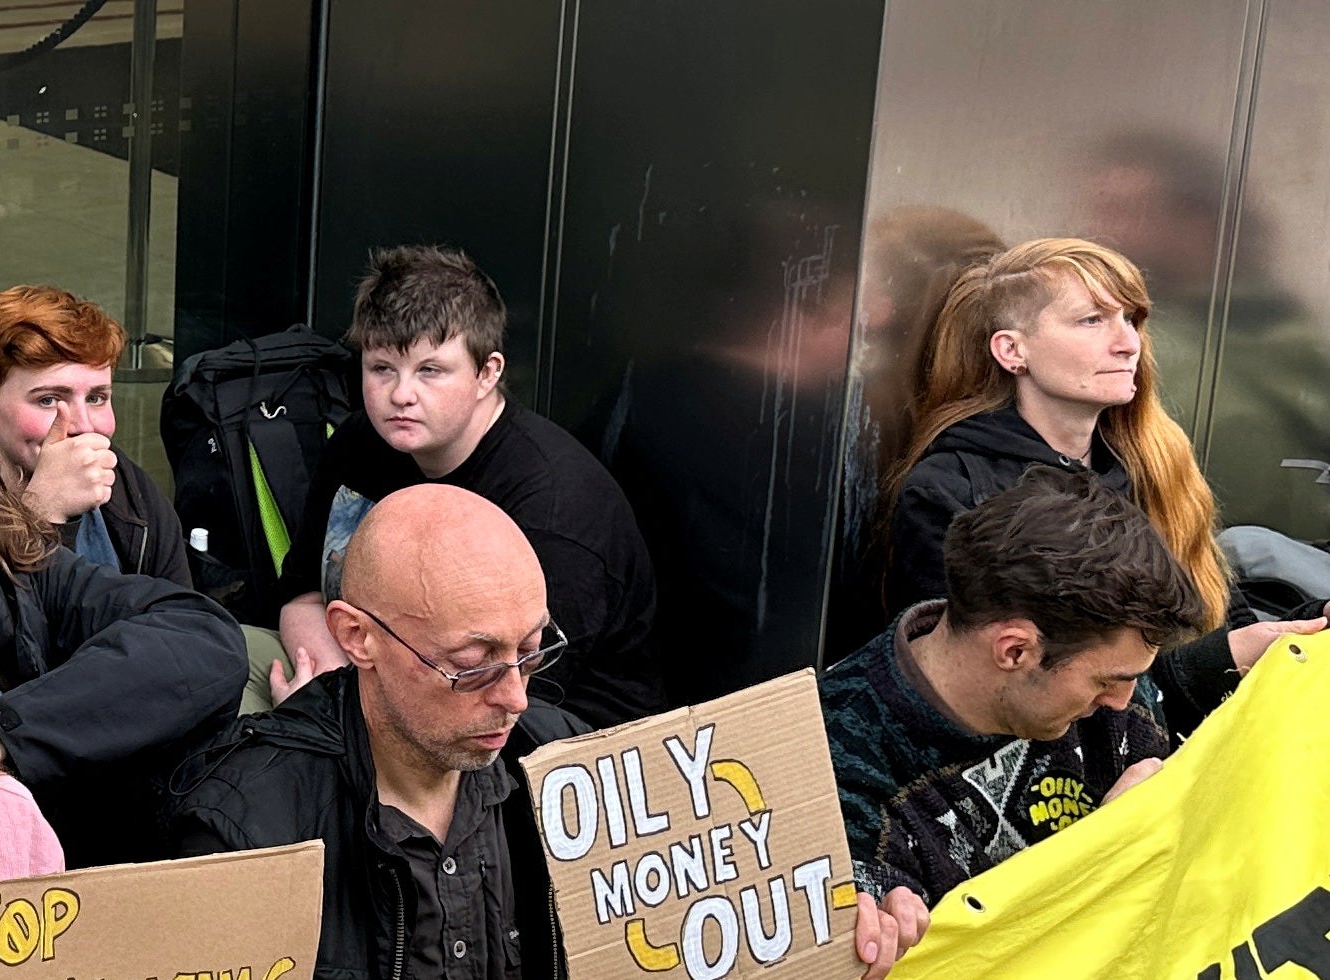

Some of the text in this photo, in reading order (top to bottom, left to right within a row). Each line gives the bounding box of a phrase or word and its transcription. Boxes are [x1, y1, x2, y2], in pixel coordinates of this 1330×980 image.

[540, 722, 716, 862] OILY
[1029, 797, 1097, 826] MONE
[1039, 776, 1084, 800] OILY
[590, 809, 772, 924] MONEY
